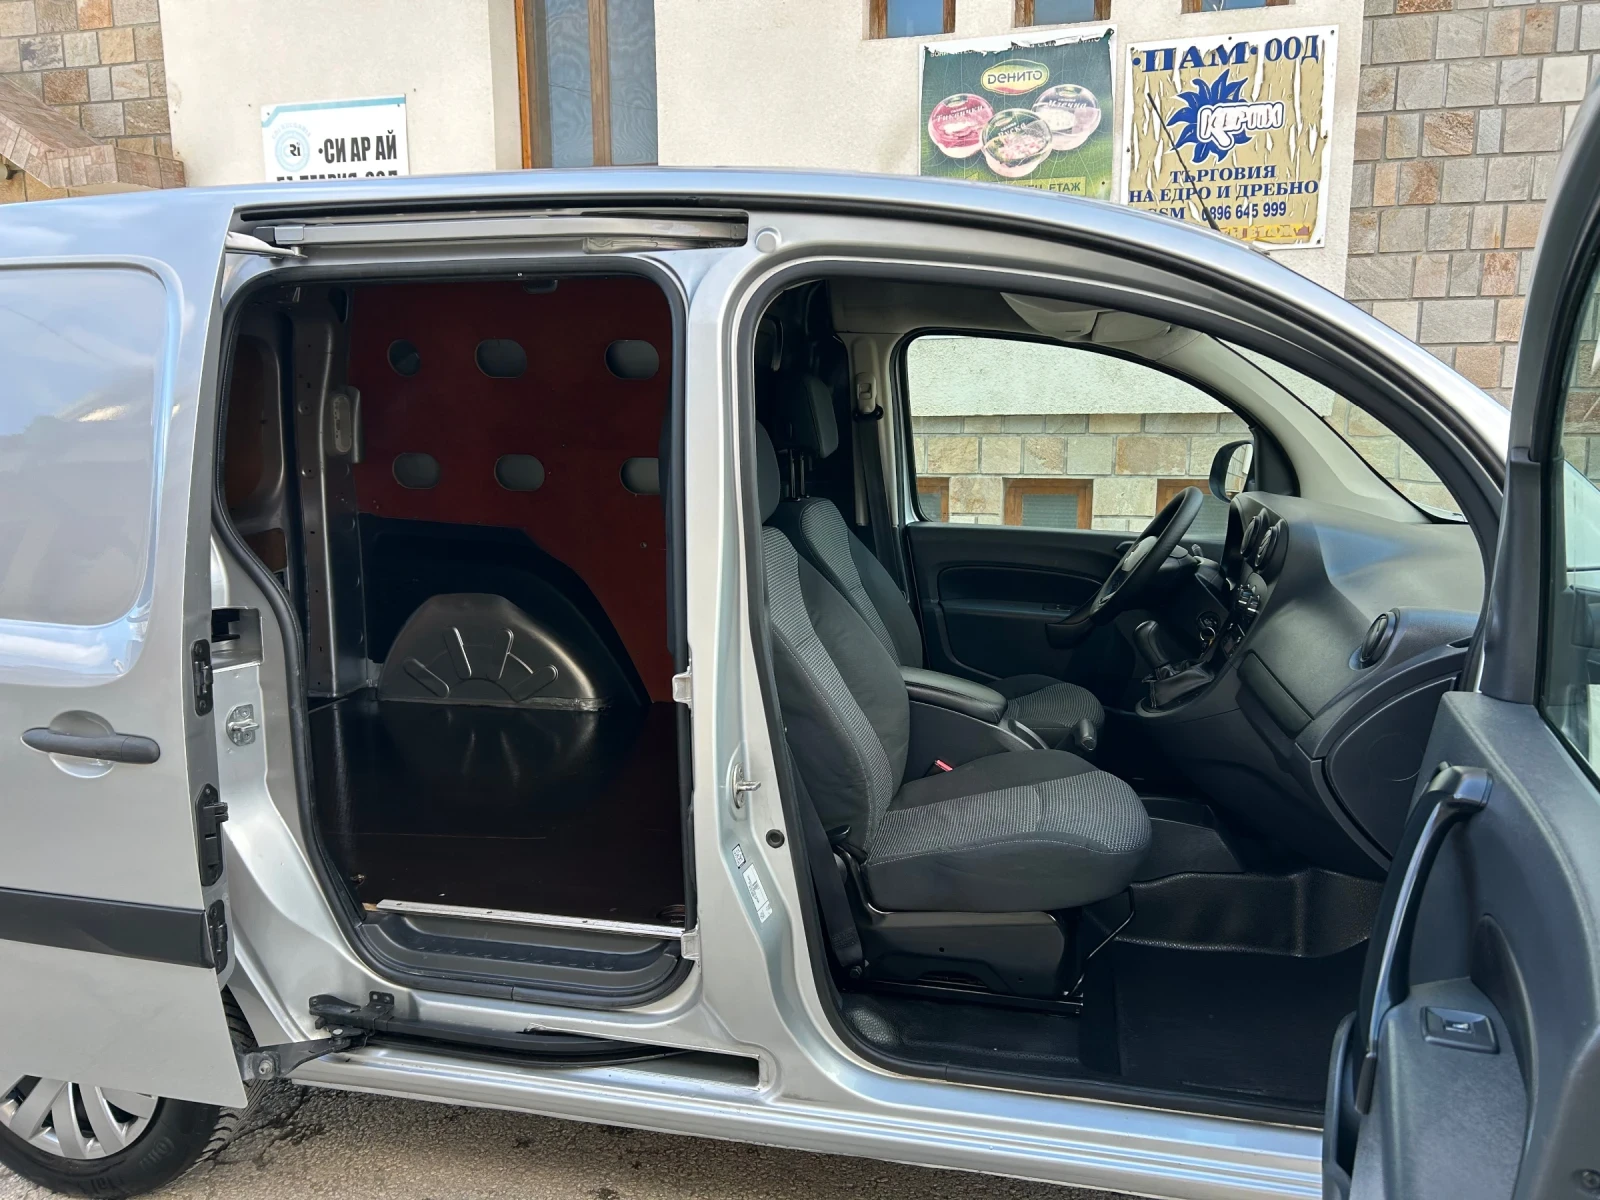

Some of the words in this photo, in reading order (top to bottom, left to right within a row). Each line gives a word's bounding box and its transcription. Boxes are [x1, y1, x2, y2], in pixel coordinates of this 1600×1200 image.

[1265, 35, 1320, 65] ООД
[350, 136, 371, 162] АР
[375, 129, 398, 161] АЙ
[1170, 165, 1276, 184] ТЪРГОВИЯ
[1129, 190, 1154, 203] НА
[1160, 187, 1211, 204] ЕДРО
[1216, 185, 1231, 199] И
[1236, 180, 1319, 200] ДРЕБНО
[1235, 203, 1259, 219] 645
[1263, 201, 1287, 217] 999
